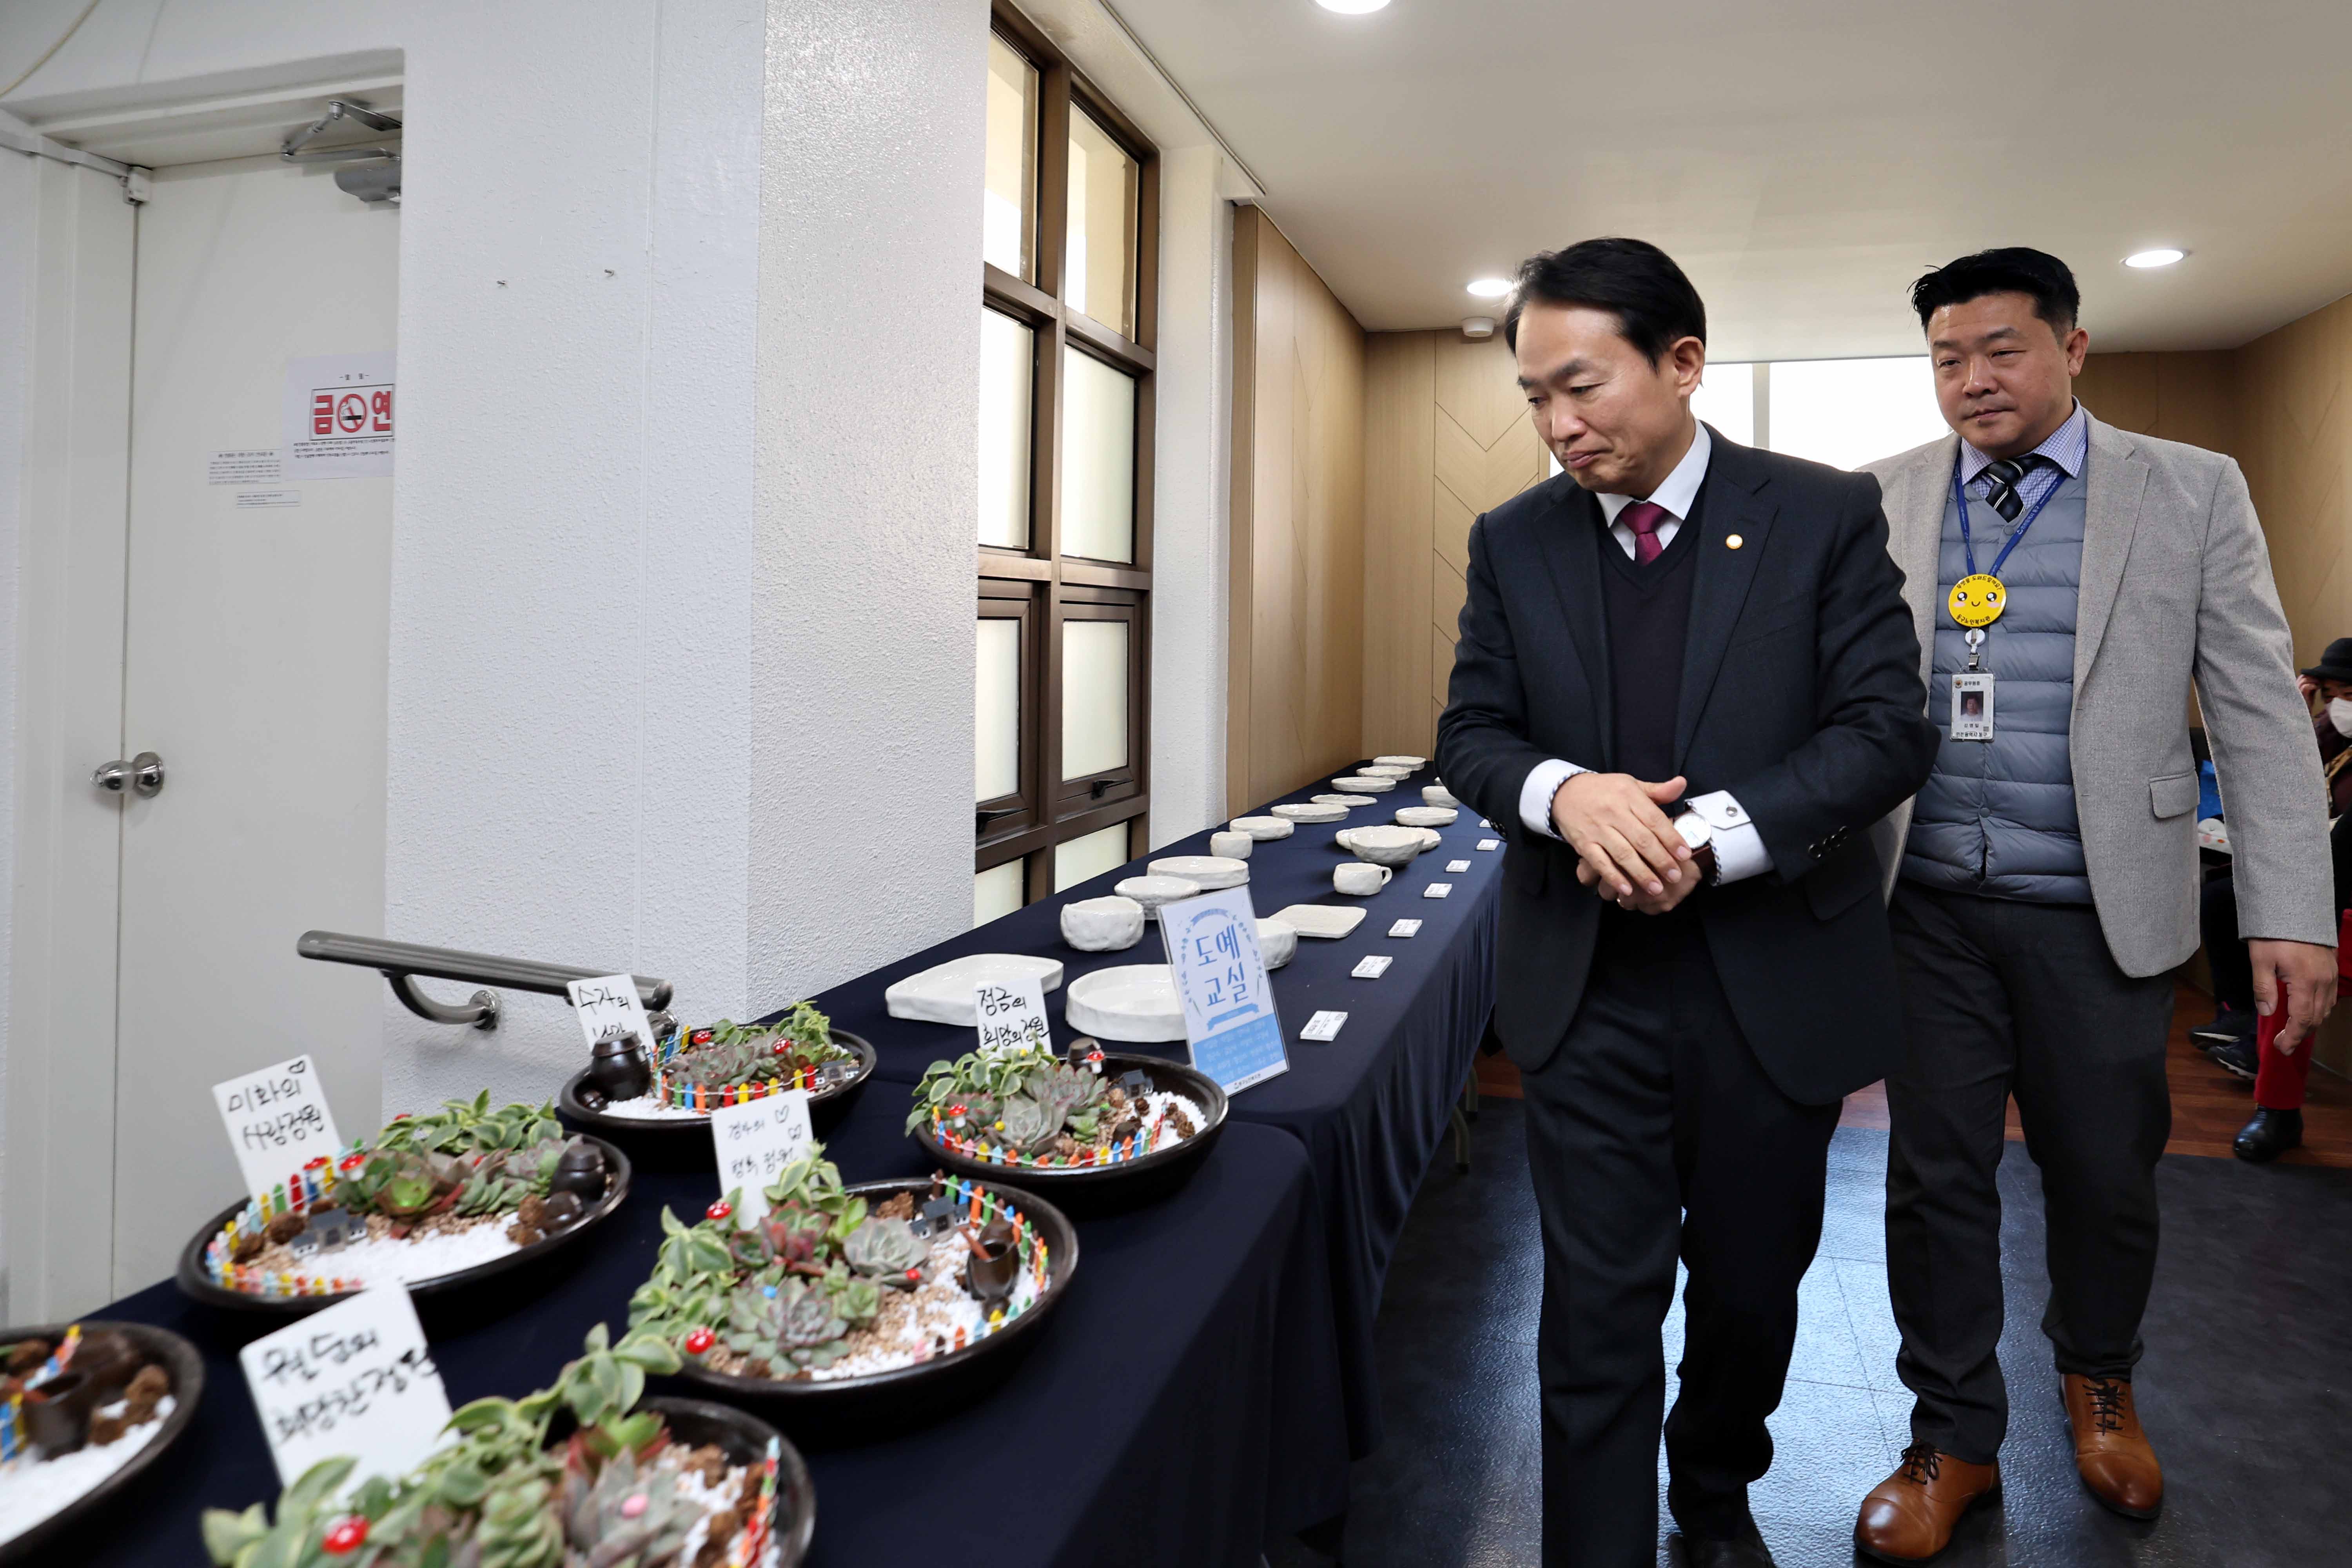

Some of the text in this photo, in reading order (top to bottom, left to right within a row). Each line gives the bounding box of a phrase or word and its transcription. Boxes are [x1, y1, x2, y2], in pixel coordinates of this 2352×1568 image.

[314, 390, 392, 434] 금 연
[1956, 614, 1991, 625] 동구노인복지관
[1196, 924, 1240, 967] 도예
[1204, 961, 1249, 1006] 교실
